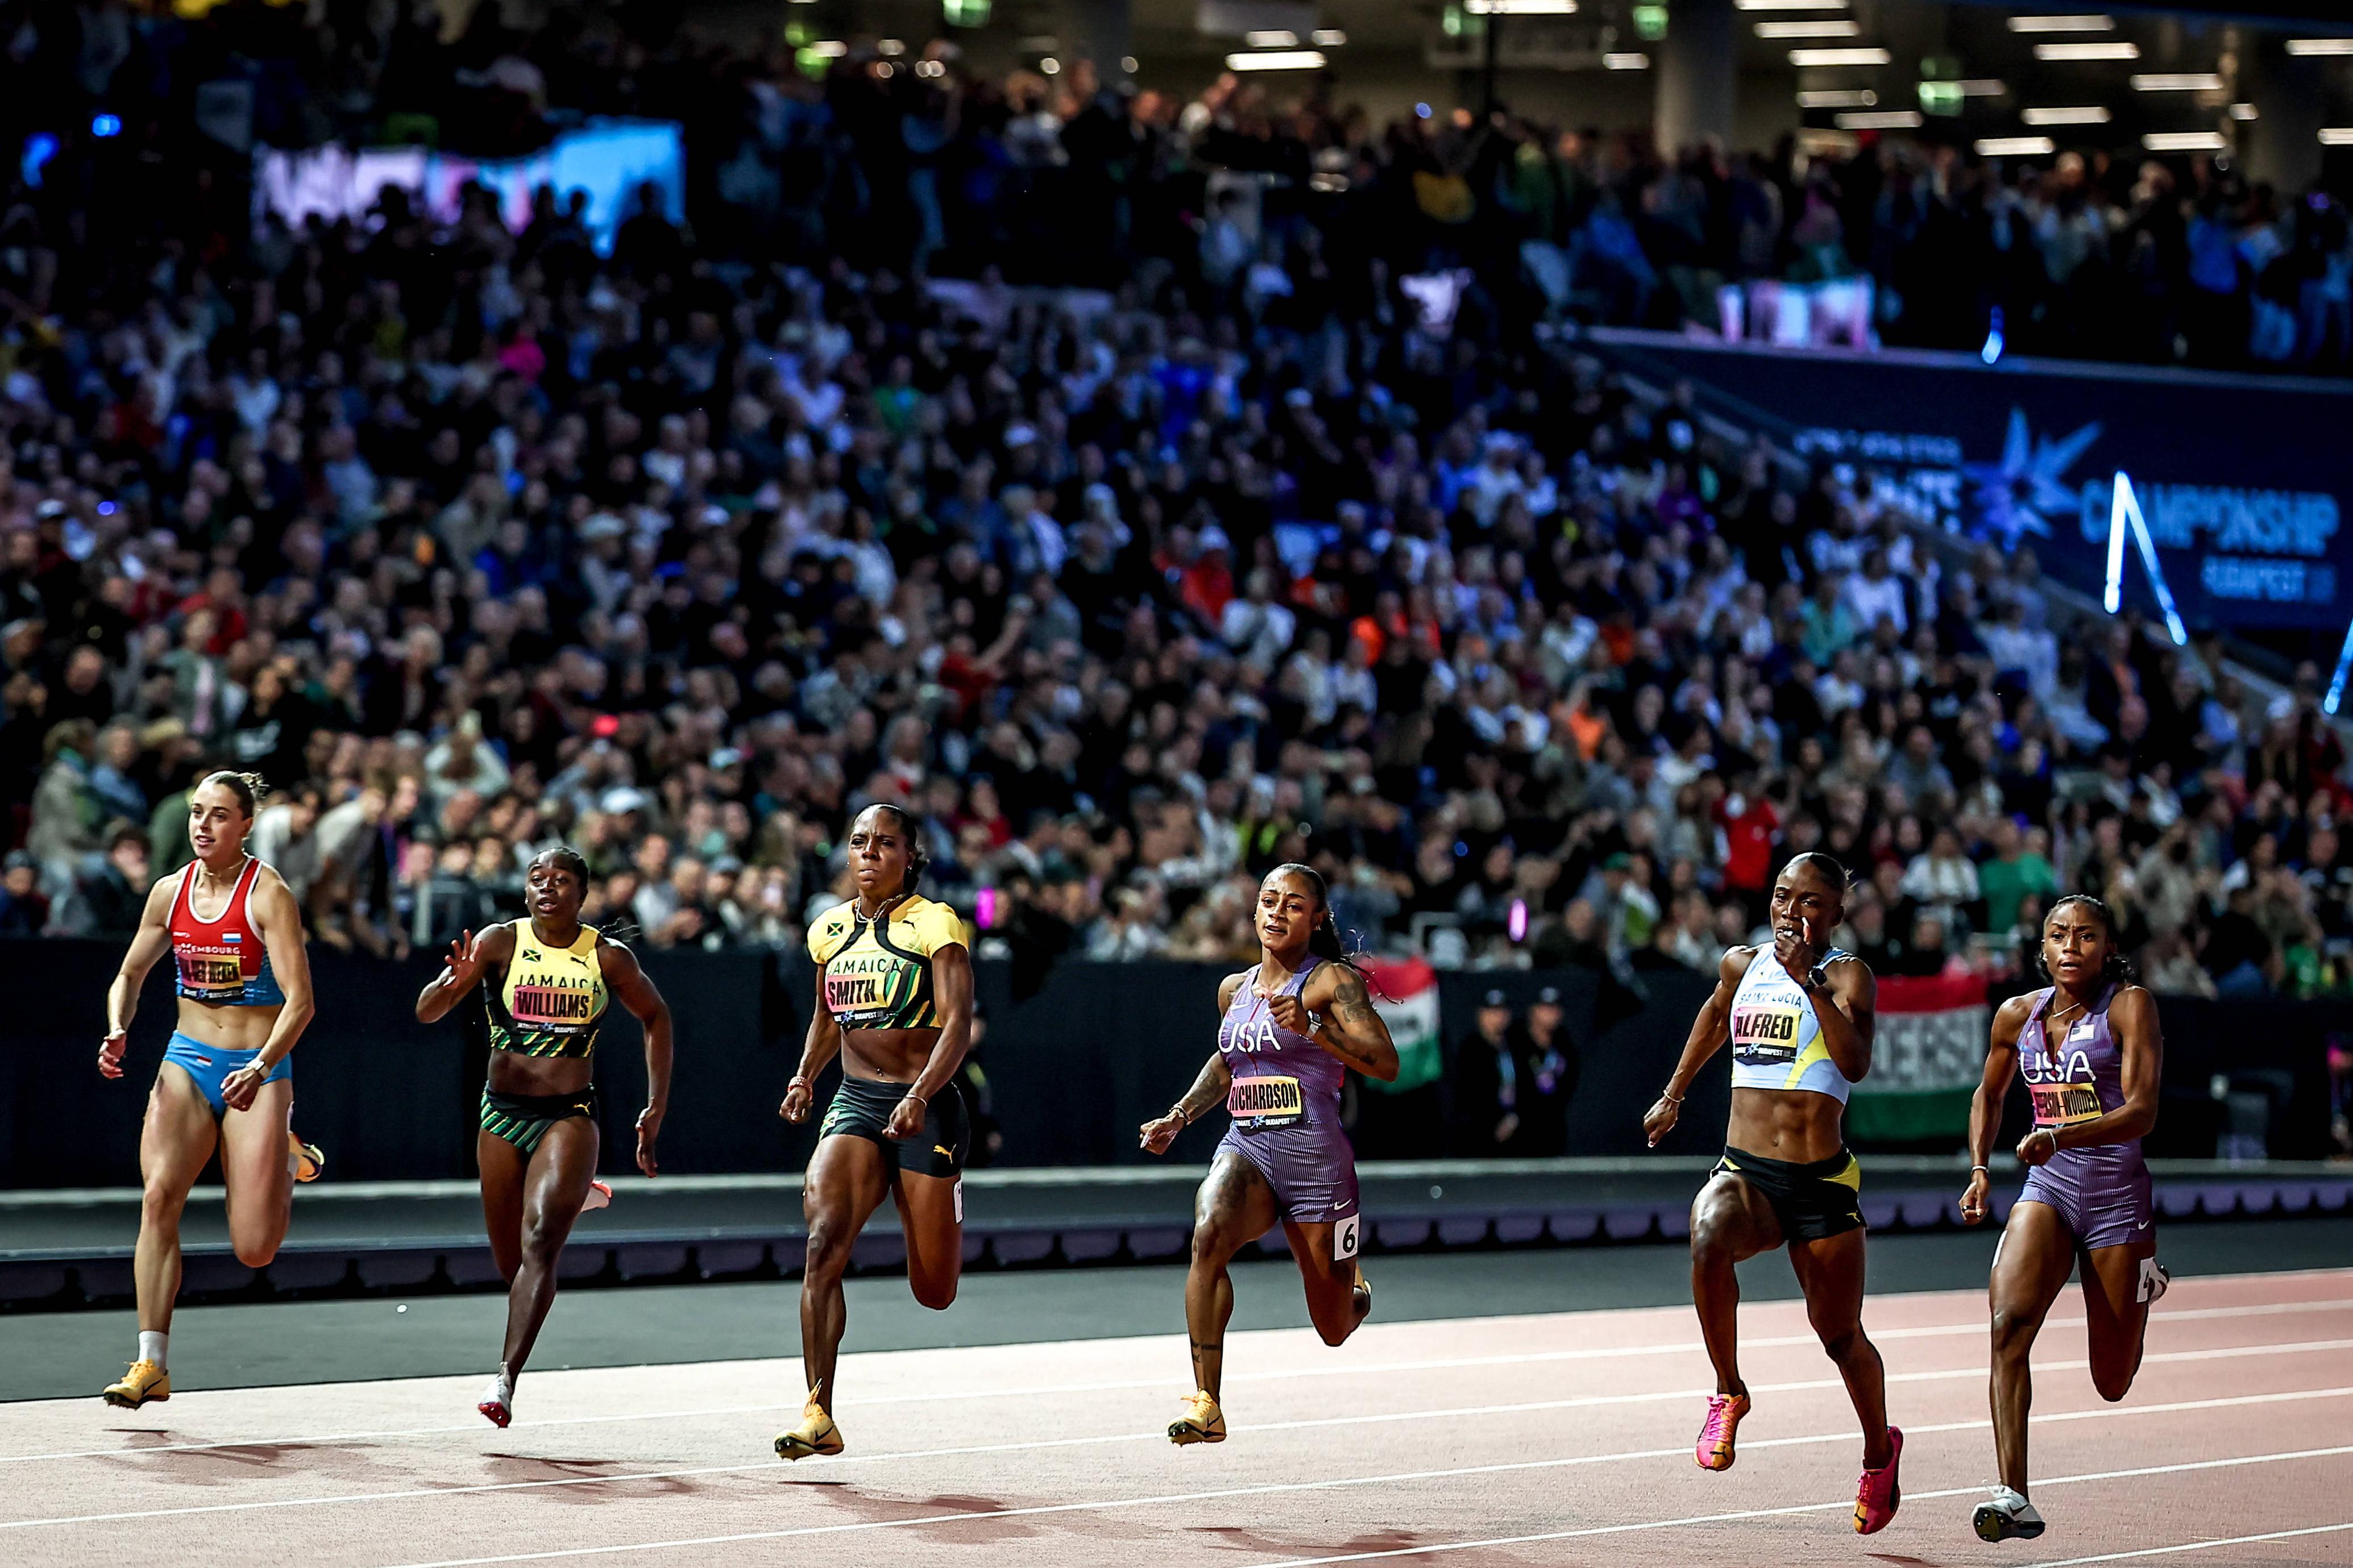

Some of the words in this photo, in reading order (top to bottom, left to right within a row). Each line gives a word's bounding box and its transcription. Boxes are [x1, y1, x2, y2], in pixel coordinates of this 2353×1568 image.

[518, 991, 590, 1018] WILLIAMS
[828, 979, 877, 1006] SMITH
[1772, 993, 1802, 1008] LUCIA
[1218, 1020, 1281, 1053] USA
[1735, 1013, 1794, 1040] ALFRED
[2020, 1050, 2097, 1083] USA
[1229, 1083, 1298, 1111] RICHARDSON
[1265, 1117, 1290, 1126] BUDAPEST
[1342, 1223, 1356, 1254] 6
